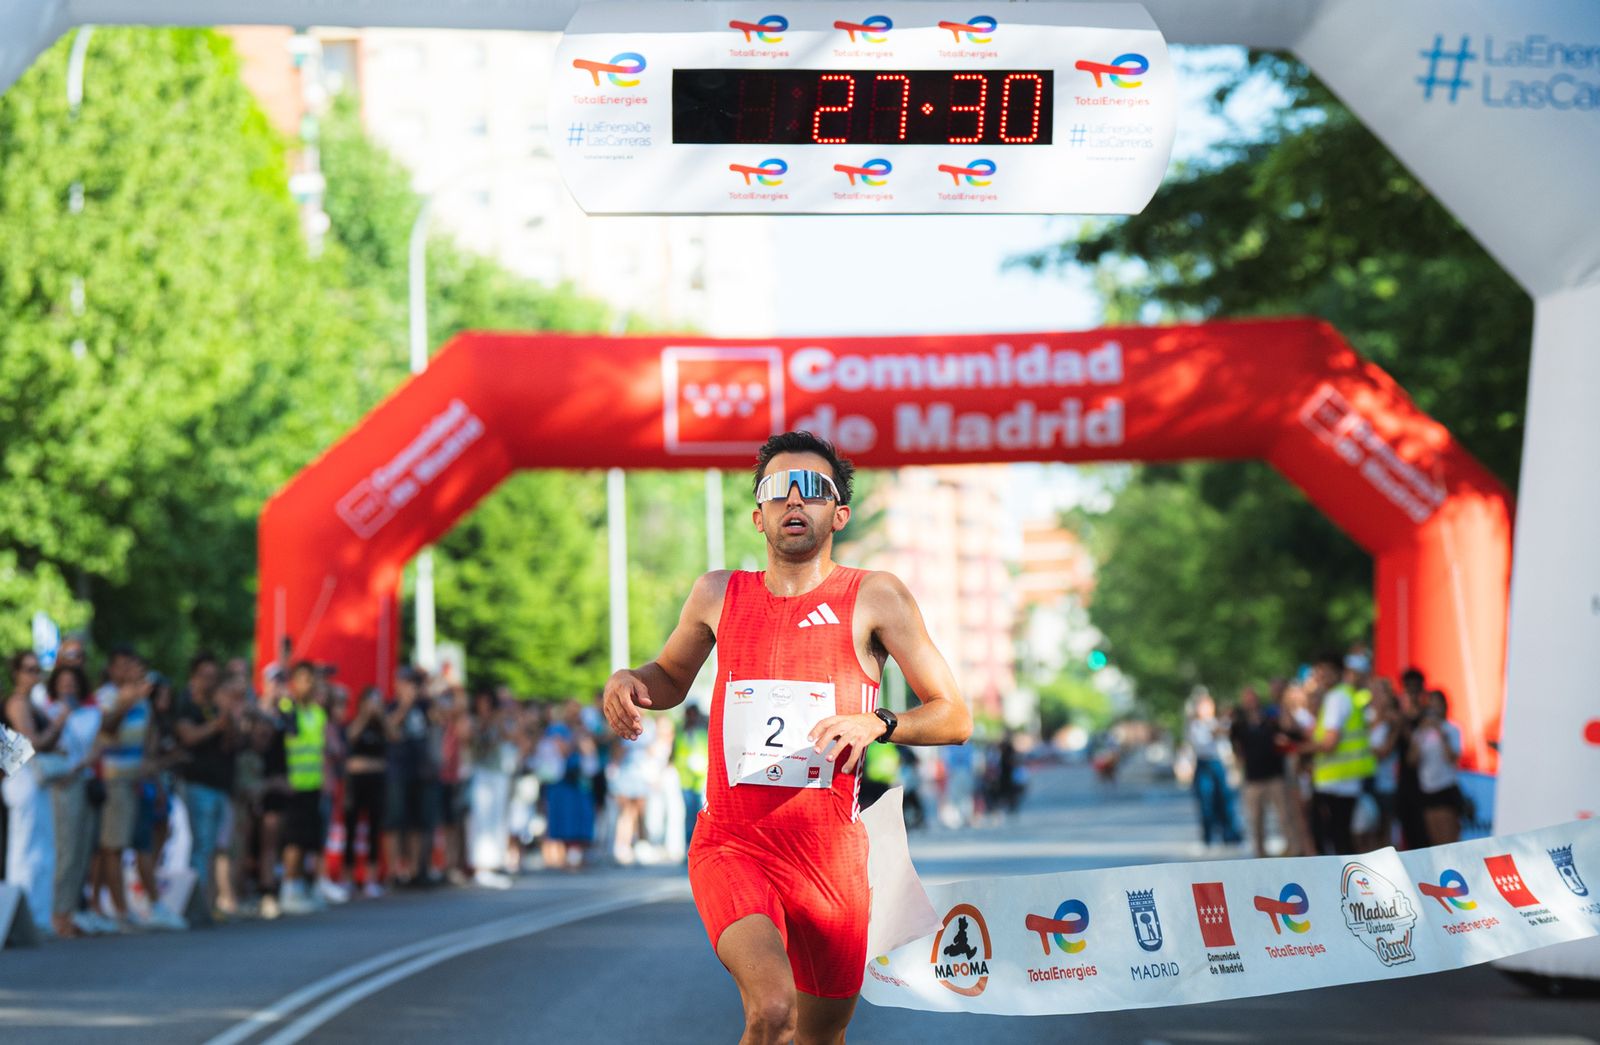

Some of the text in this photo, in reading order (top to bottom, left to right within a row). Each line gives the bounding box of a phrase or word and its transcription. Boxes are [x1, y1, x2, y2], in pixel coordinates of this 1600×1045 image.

[573, 94, 648, 106] TotalEnergies
[1075, 96, 1150, 108] TotalEnergies
[788, 341, 1124, 391] Comunidad
[894, 397, 1125, 451] Madrid
[765, 716, 785, 748] 2
[1349, 899, 1400, 921] Madrid
[1443, 916, 1500, 936] TotalEnergies
[1207, 951, 1241, 962] Comunidad
[1265, 942, 1327, 959] TotalEnergies
[934, 960, 990, 979] MAPOMA
[1027, 963, 1098, 983] TotalEnergies
[1131, 962, 1180, 981] MADRID
[1210, 963, 1245, 975] de Madrid
